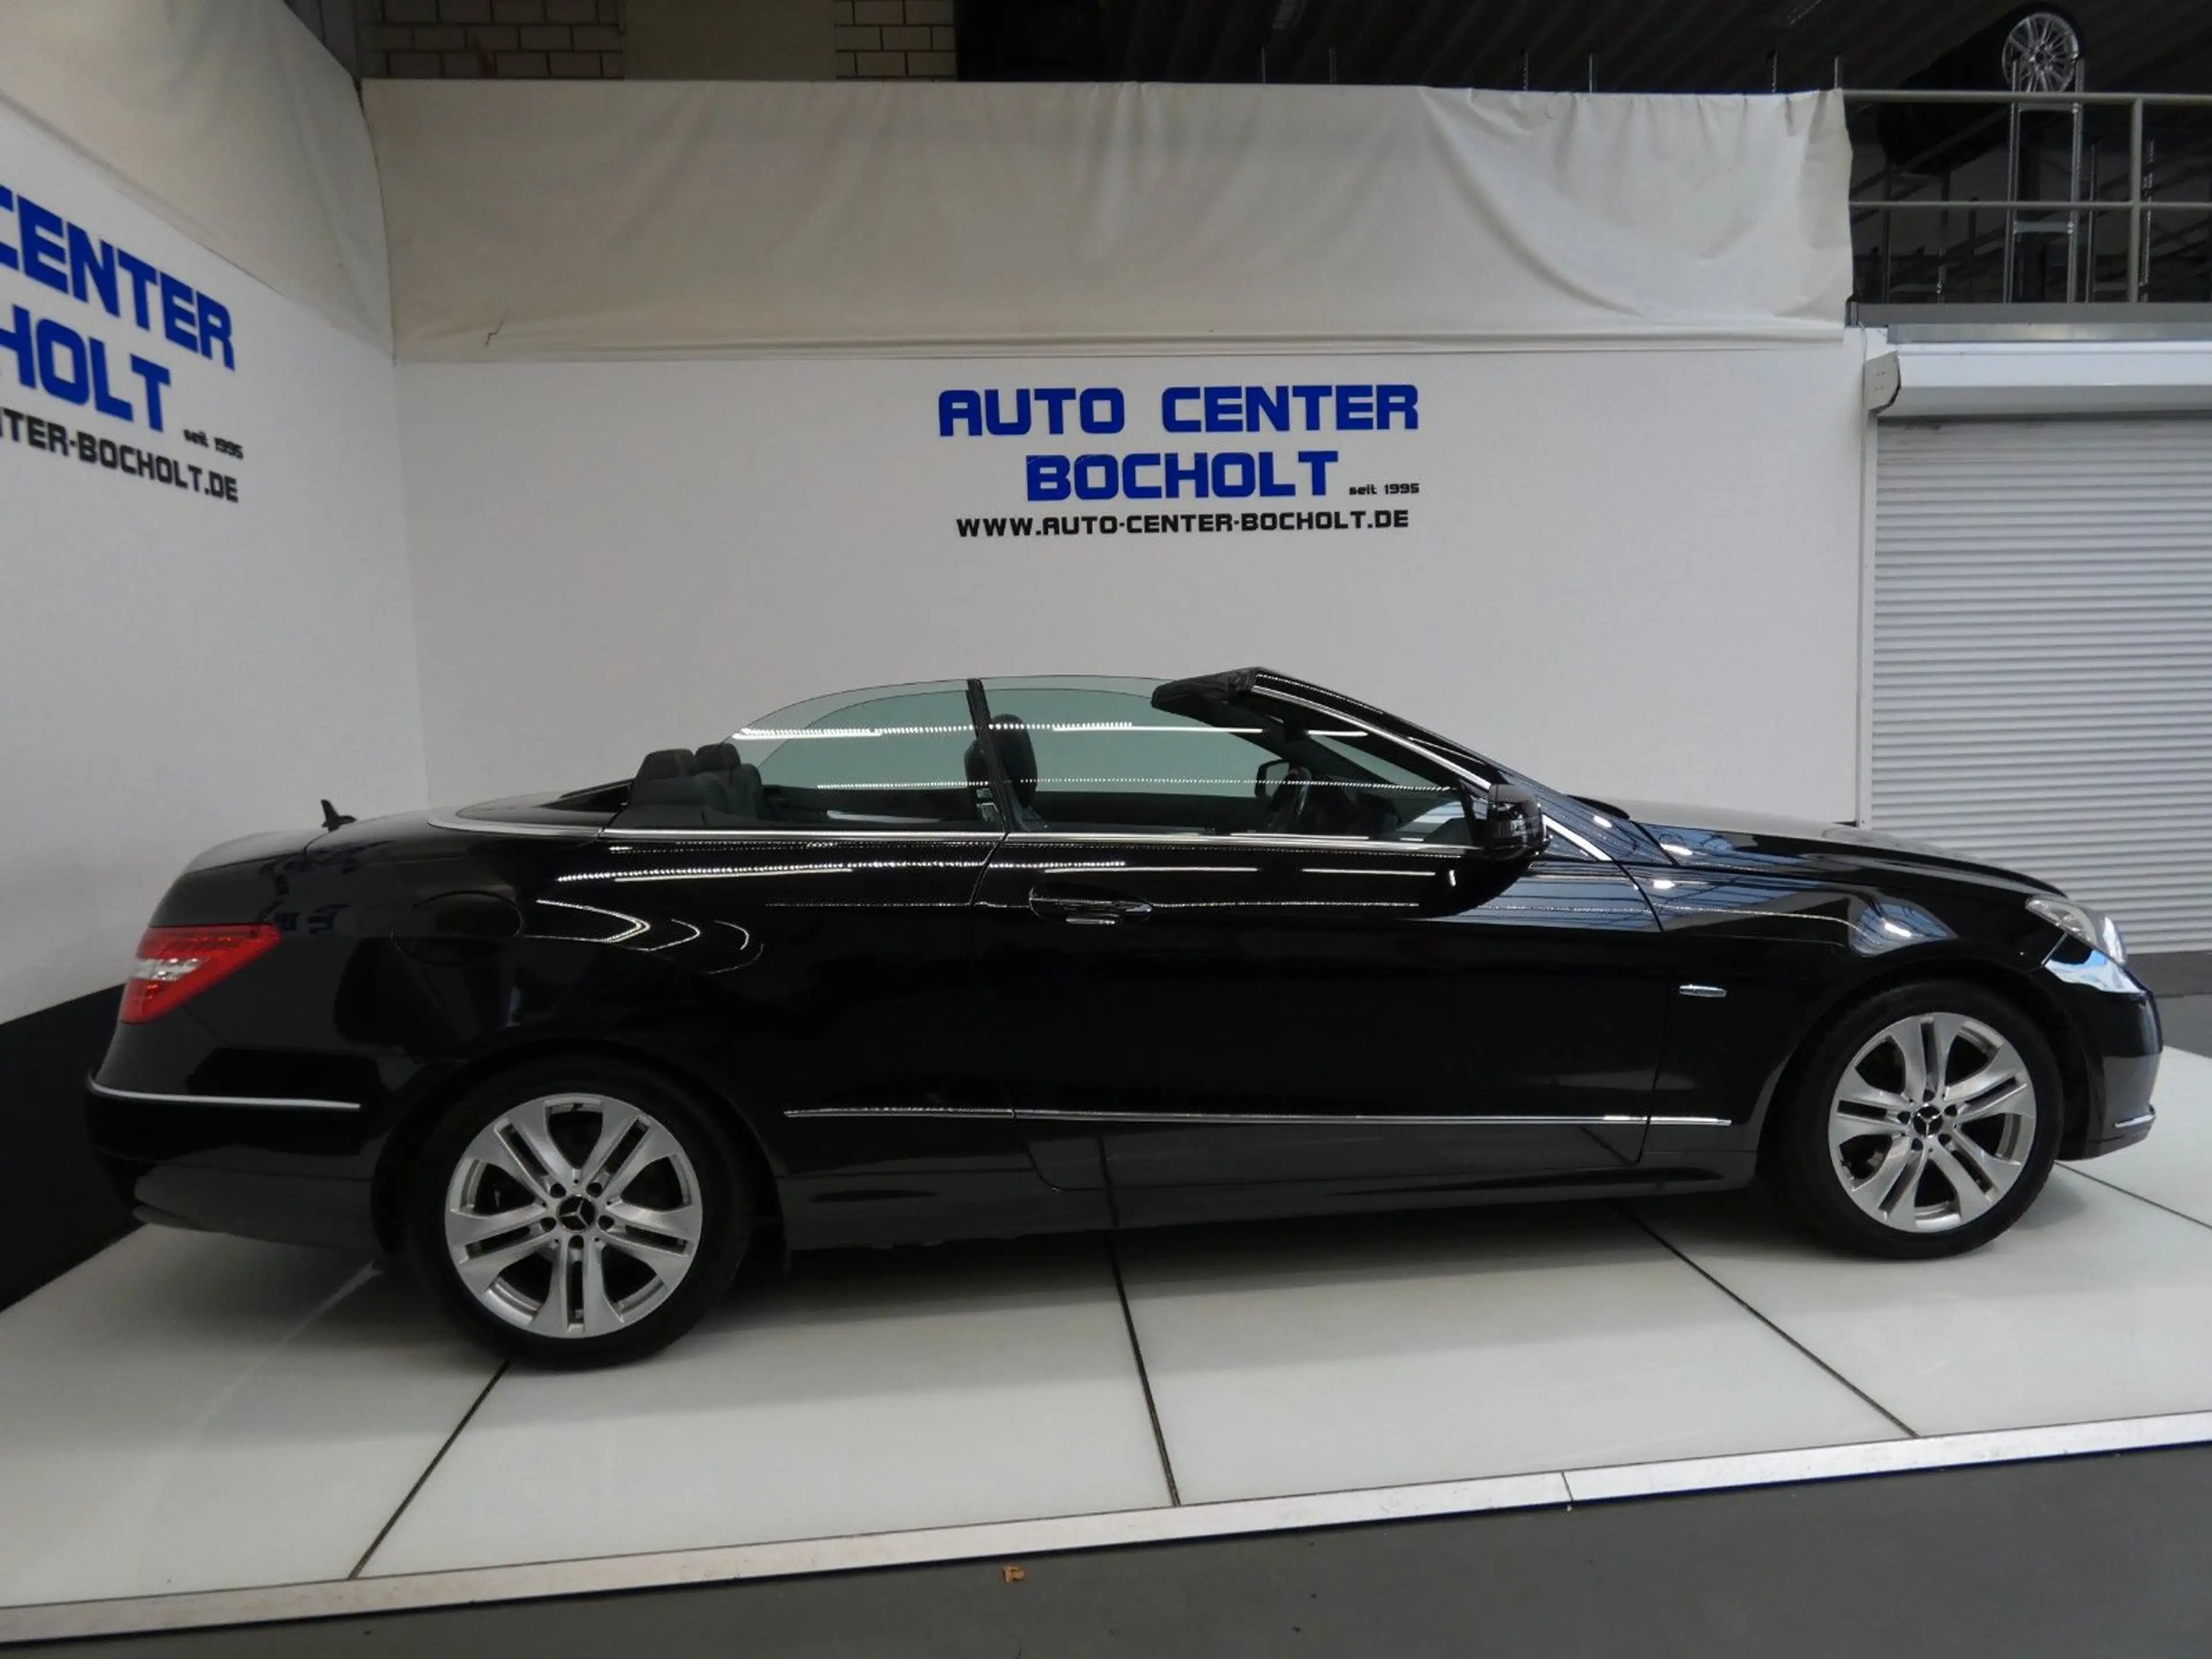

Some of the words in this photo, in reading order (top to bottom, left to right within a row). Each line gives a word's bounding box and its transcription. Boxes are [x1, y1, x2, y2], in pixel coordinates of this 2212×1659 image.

[938, 388, 1125, 437] AUTO
[1161, 385, 1419, 434] CENTER
[0, 407, 239, 504] TER-BOCHOLT.DE
[1026, 451, 1339, 502] BOCHOLT
[1349, 484, 1377, 496] seit
[1385, 483, 1419, 495] 1995
[956, 510, 1409, 538] WWW.AUTO-CENTER-BOCHOLT.DE
